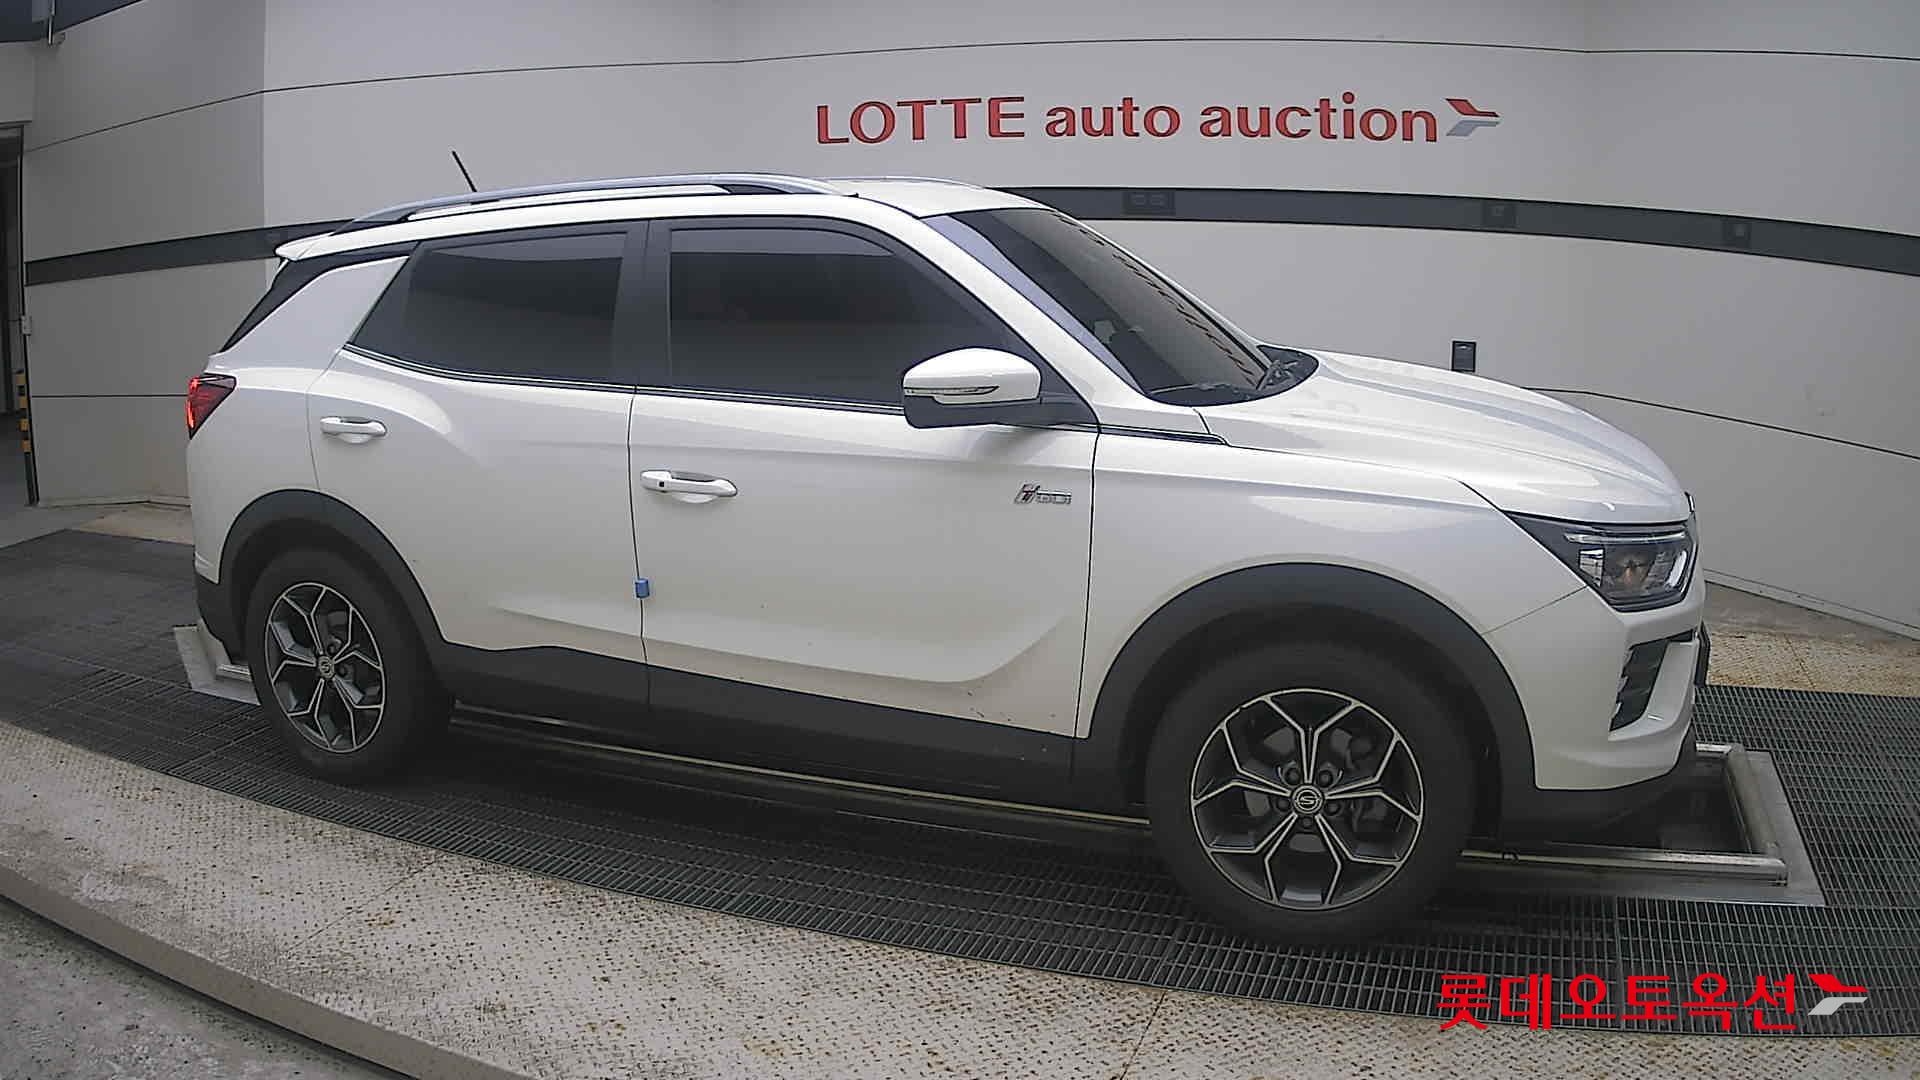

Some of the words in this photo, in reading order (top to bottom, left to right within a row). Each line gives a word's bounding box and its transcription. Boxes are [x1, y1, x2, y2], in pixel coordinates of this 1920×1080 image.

[817, 96, 1025, 144] LOTTE
[1045, 96, 1181, 138] auto
[1200, 91, 1438, 142] auction
